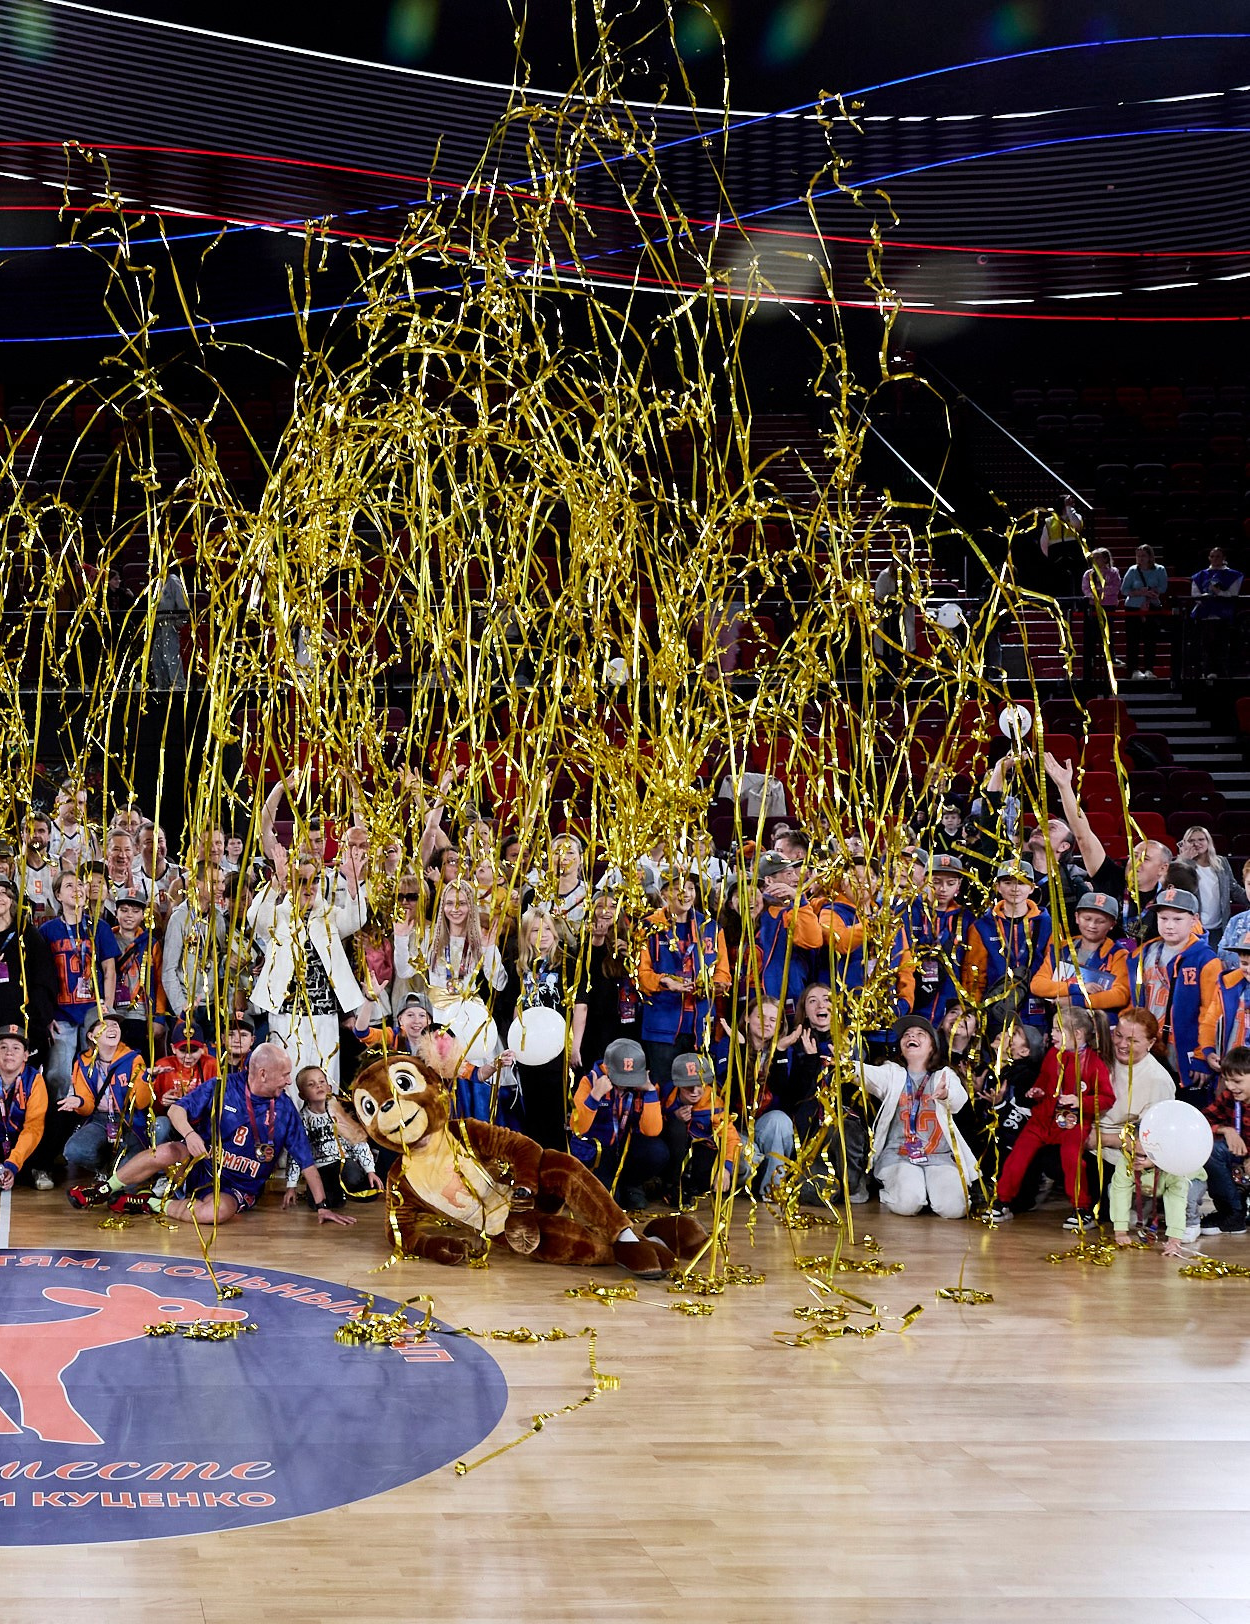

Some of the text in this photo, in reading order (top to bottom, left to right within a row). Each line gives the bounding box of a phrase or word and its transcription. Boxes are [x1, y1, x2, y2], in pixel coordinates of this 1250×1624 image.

[34, 880, 43, 894] 9
[54, 953, 97, 1004] 12
[1181, 967, 1197, 985] 12
[623, 1057, 634, 1071] 12
[685, 1061, 698, 1077] 12
[118, 1073, 129, 1087] 12
[233, 1126, 249, 1147] 8
[898, 1109, 944, 1156] 12
[32, 1491, 276, 1508] КУЦЕНКО
